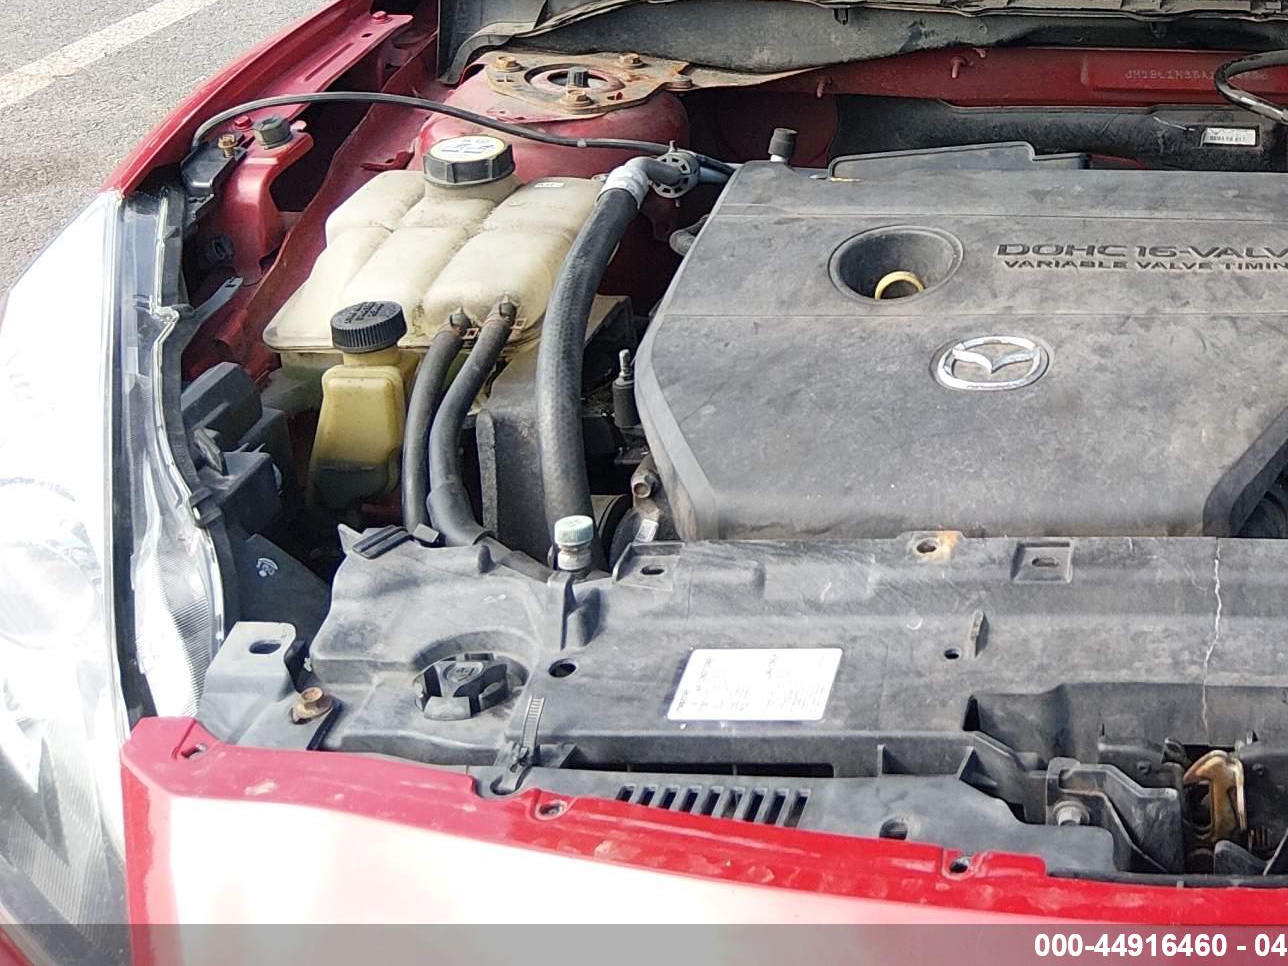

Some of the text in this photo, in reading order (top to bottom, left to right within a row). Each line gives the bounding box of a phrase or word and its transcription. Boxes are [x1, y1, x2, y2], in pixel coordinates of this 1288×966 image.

[997, 243, 1128, 257] DOHC
[1004, 259, 1129, 270] VARIABLE
[1135, 260, 1214, 271] VALVE
